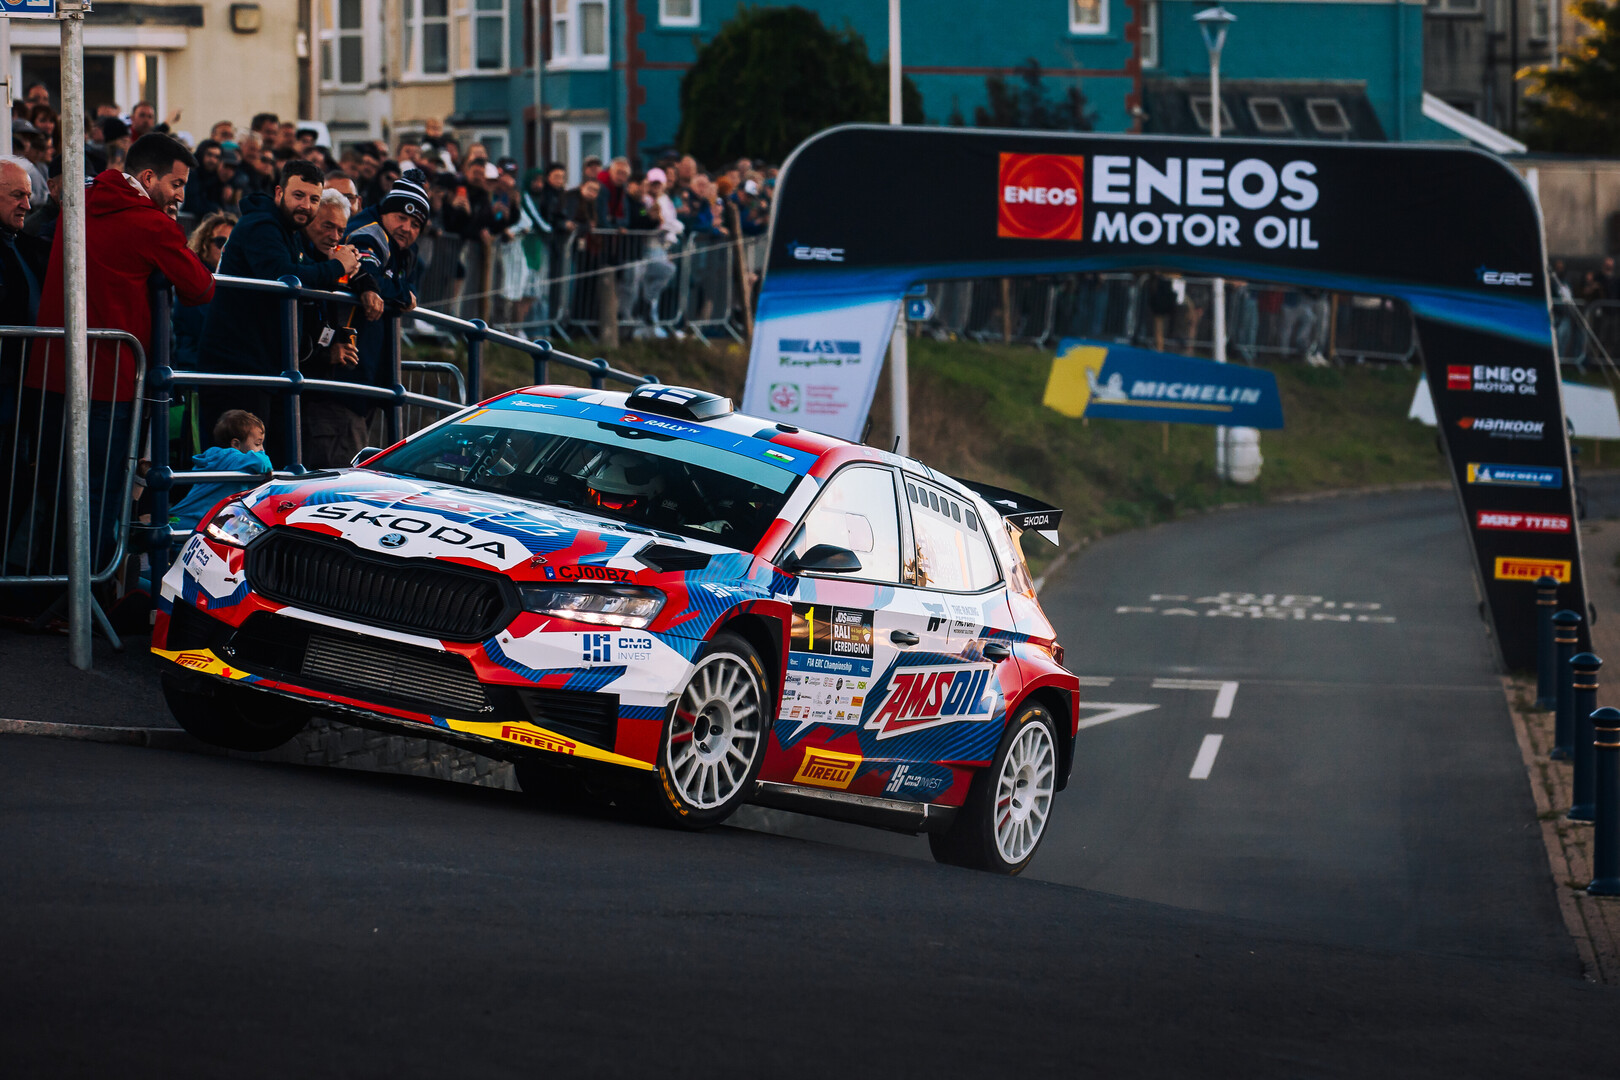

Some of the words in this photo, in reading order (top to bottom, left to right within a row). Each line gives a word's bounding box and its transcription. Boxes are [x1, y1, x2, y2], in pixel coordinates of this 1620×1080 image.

[1092, 155, 1319, 211] ENEOS
[1003, 185, 1078, 206] ENEOS
[1092, 211, 1242, 246] MOTOR
[1254, 215, 1319, 249] OIL
[1473, 365, 1537, 384] ENEOS
[1130, 380, 1262, 404] MICHELIN
[1473, 382, 1514, 393] MOTOR
[1518, 385, 1537, 395] OIL
[644, 420, 688, 431] RALLY
[1023, 515, 1049, 526] SKODA
[1480, 513, 1523, 527] MRF
[1525, 516, 1569, 529] TYRES
[308, 506, 506, 560] SKODA
[558, 565, 632, 583] CJ00BZ
[836, 612, 848, 623] JDS
[804, 606, 815, 651] 1
[834, 624, 851, 640] RALI
[618, 637, 652, 649] CM3
[833, 640, 870, 655] CEREDIGION
[617, 652, 652, 661] INVEST
[872, 669, 991, 733] AMSOIL
[501, 726, 576, 756] PIRELLI
[801, 754, 855, 782] PIRELLI
